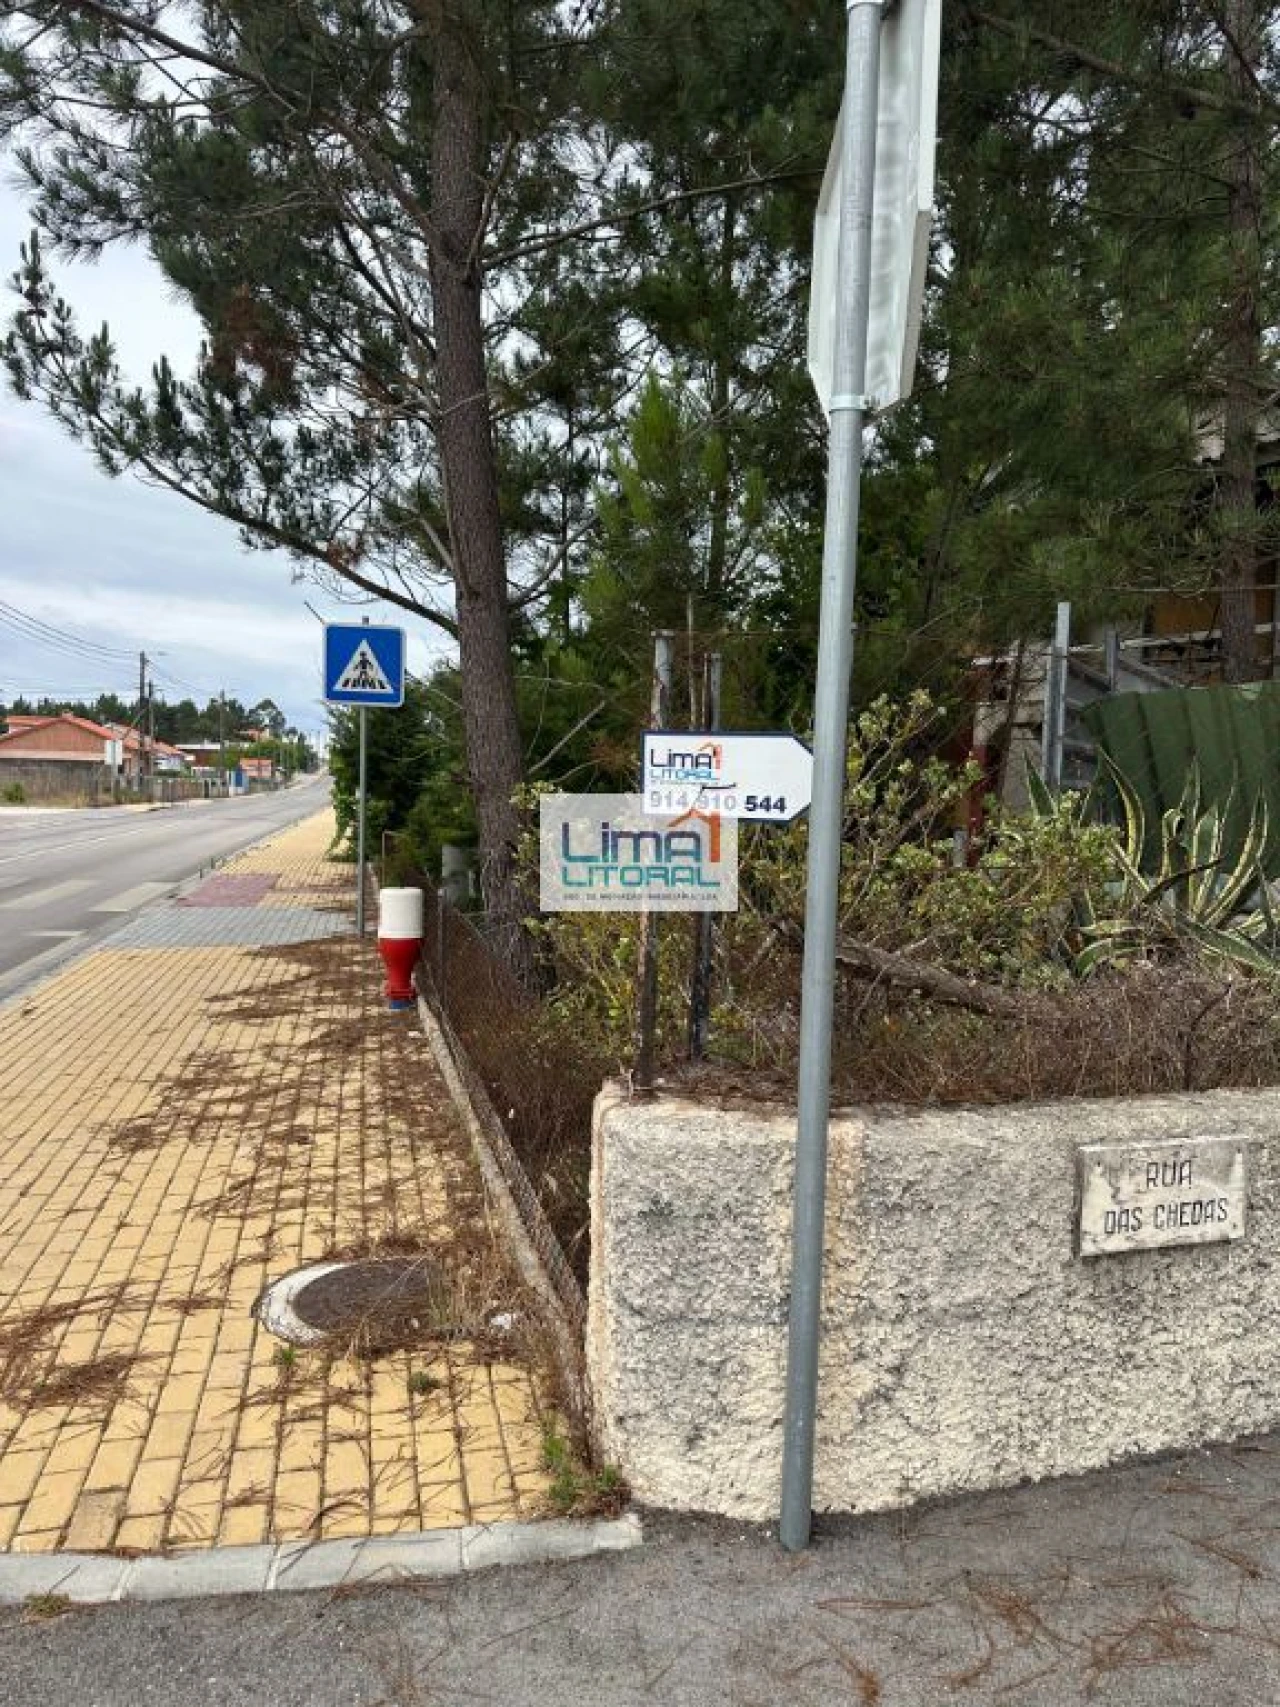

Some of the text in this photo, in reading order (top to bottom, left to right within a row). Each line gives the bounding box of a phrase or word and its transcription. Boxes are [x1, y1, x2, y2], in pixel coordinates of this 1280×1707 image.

[650, 790, 787, 813] 914 910 544
[1146, 1160, 1193, 1189] RUA
[1104, 1198, 1228, 1235] DAS CHEDAS
